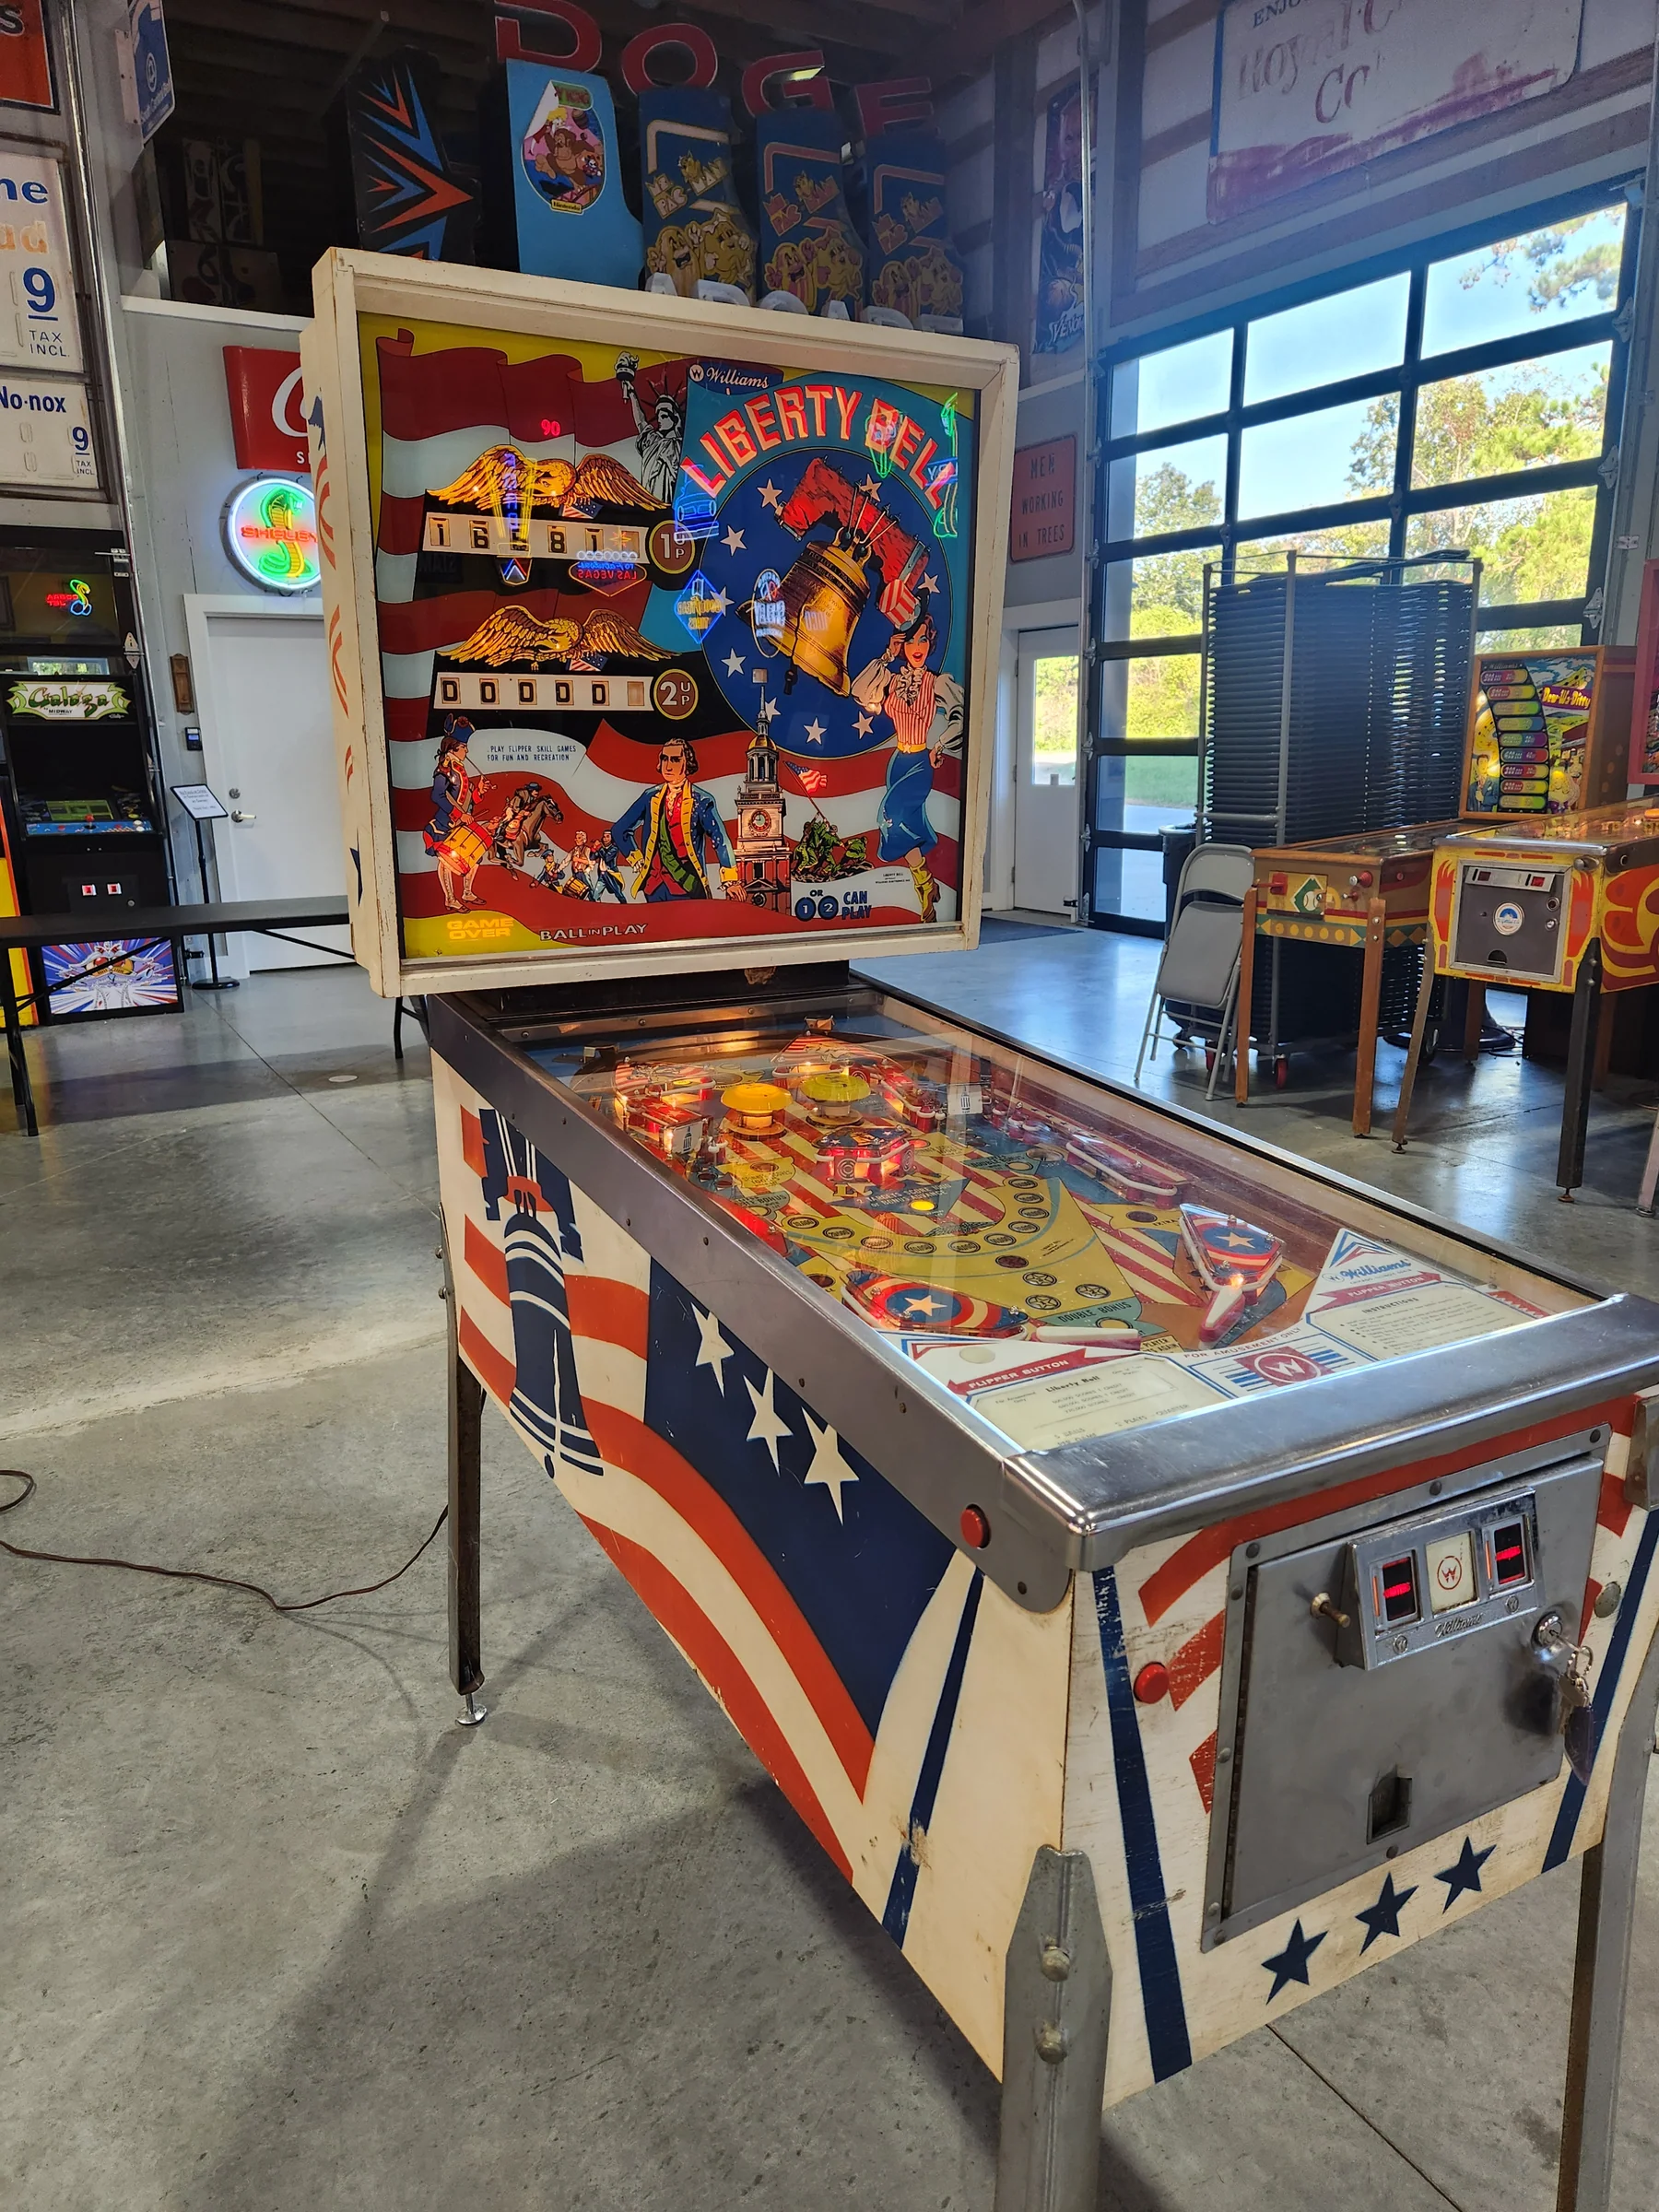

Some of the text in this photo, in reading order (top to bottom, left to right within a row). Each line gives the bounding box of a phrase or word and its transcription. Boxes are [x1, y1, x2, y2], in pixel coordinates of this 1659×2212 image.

[23, 267, 55, 313] 9
[29, 330, 63, 344] TAX
[706, 366, 770, 390] Williams
[72, 426, 89, 452] 9
[680, 384, 955, 510] LIBERTY BELL
[1030, 452, 1055, 479] MEN
[1021, 489, 1065, 515] WORKING
[241, 525, 317, 543] SHELBY
[1018, 524, 1065, 548] IN TREES
[29, 685, 110, 718] Galaga
[659, 680, 677, 706] 2
[487, 754, 570, 762] FOR FUN AND RECREATION
[490, 745, 577, 753] PLAY FLIPPER SKILL GAMES
[809, 889, 824, 898] OR
[842, 890, 868, 905] CAN
[841, 904, 873, 920] PLAY
[446, 918, 514, 930] GAME
[449, 927, 512, 940] OVER
[539, 924, 647, 941] BALL IN PLAY
[1339, 1259, 1412, 1279] Williams
[1347, 1276, 1425, 1298] FLIPPER BUTTON
[1057, 1300, 1133, 1323] DOUBLE BONUS
[1361, 1297, 1419, 1314] INSTRUCTIONS
[1142, 1337, 1169, 1348] PLAYER
[1213, 1336, 1279, 1356] AMUSEMENT
[1280, 1326, 1301, 1338] ONLY
[968, 1359, 1070, 1389] FLIPPER BUTTON
[1045, 1375, 1101, 1393] Liberty Bell
[1434, 1612, 1484, 1639] Williams
